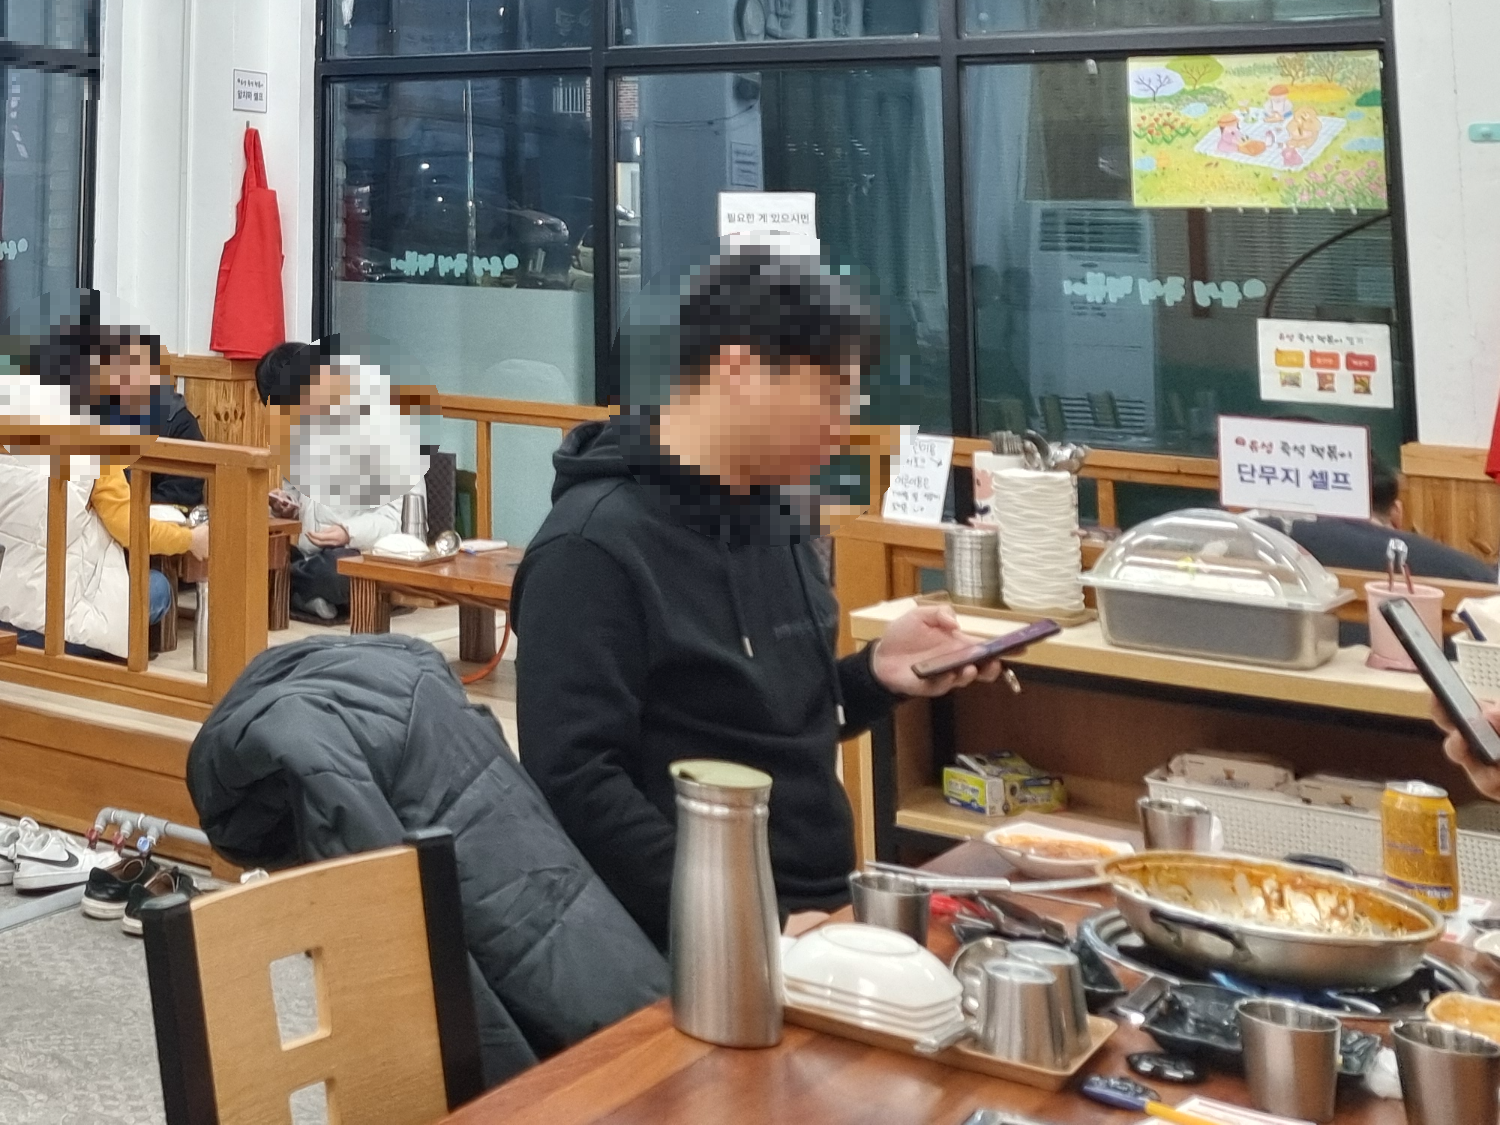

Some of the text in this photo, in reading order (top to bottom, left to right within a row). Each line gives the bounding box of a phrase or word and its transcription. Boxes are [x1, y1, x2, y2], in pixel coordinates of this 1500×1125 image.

[727, 214, 754, 224] 필요한
[771, 213, 810, 225] 있으시면
[1238, 463, 1352, 491] 단무지 셀프
